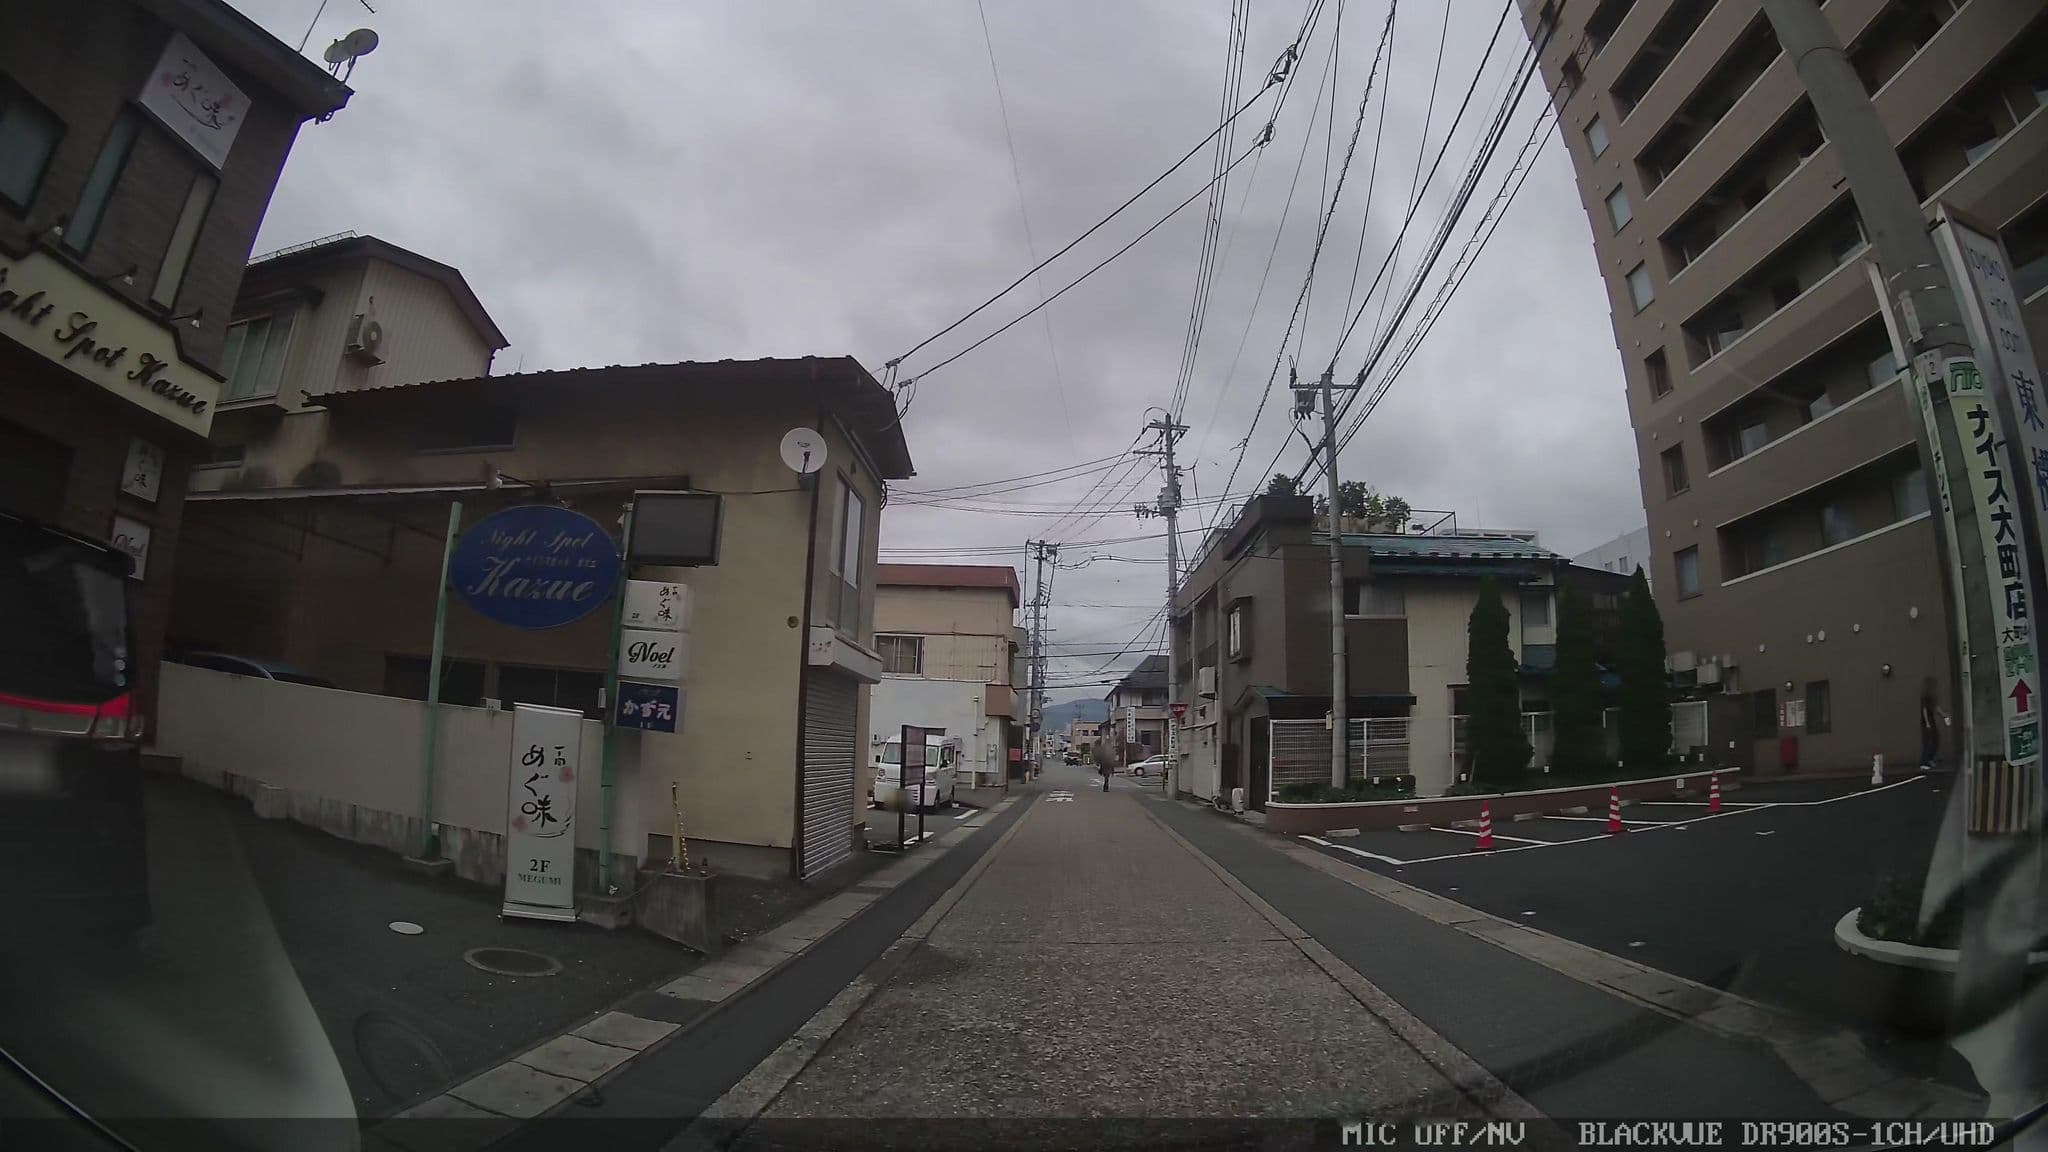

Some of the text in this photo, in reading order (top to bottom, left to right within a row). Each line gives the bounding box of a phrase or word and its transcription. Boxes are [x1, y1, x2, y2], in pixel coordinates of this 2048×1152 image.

[54, 311, 129, 369] Spot
[126, 352, 208, 414] Kazue
[1966, 403, 2029, 620] ナイス大町店
[466, 555, 595, 602] Kazue
[627, 641, 676, 664] Noel
[520, 744, 558, 829] めぐ味
[529, 858, 551, 873] 2F
